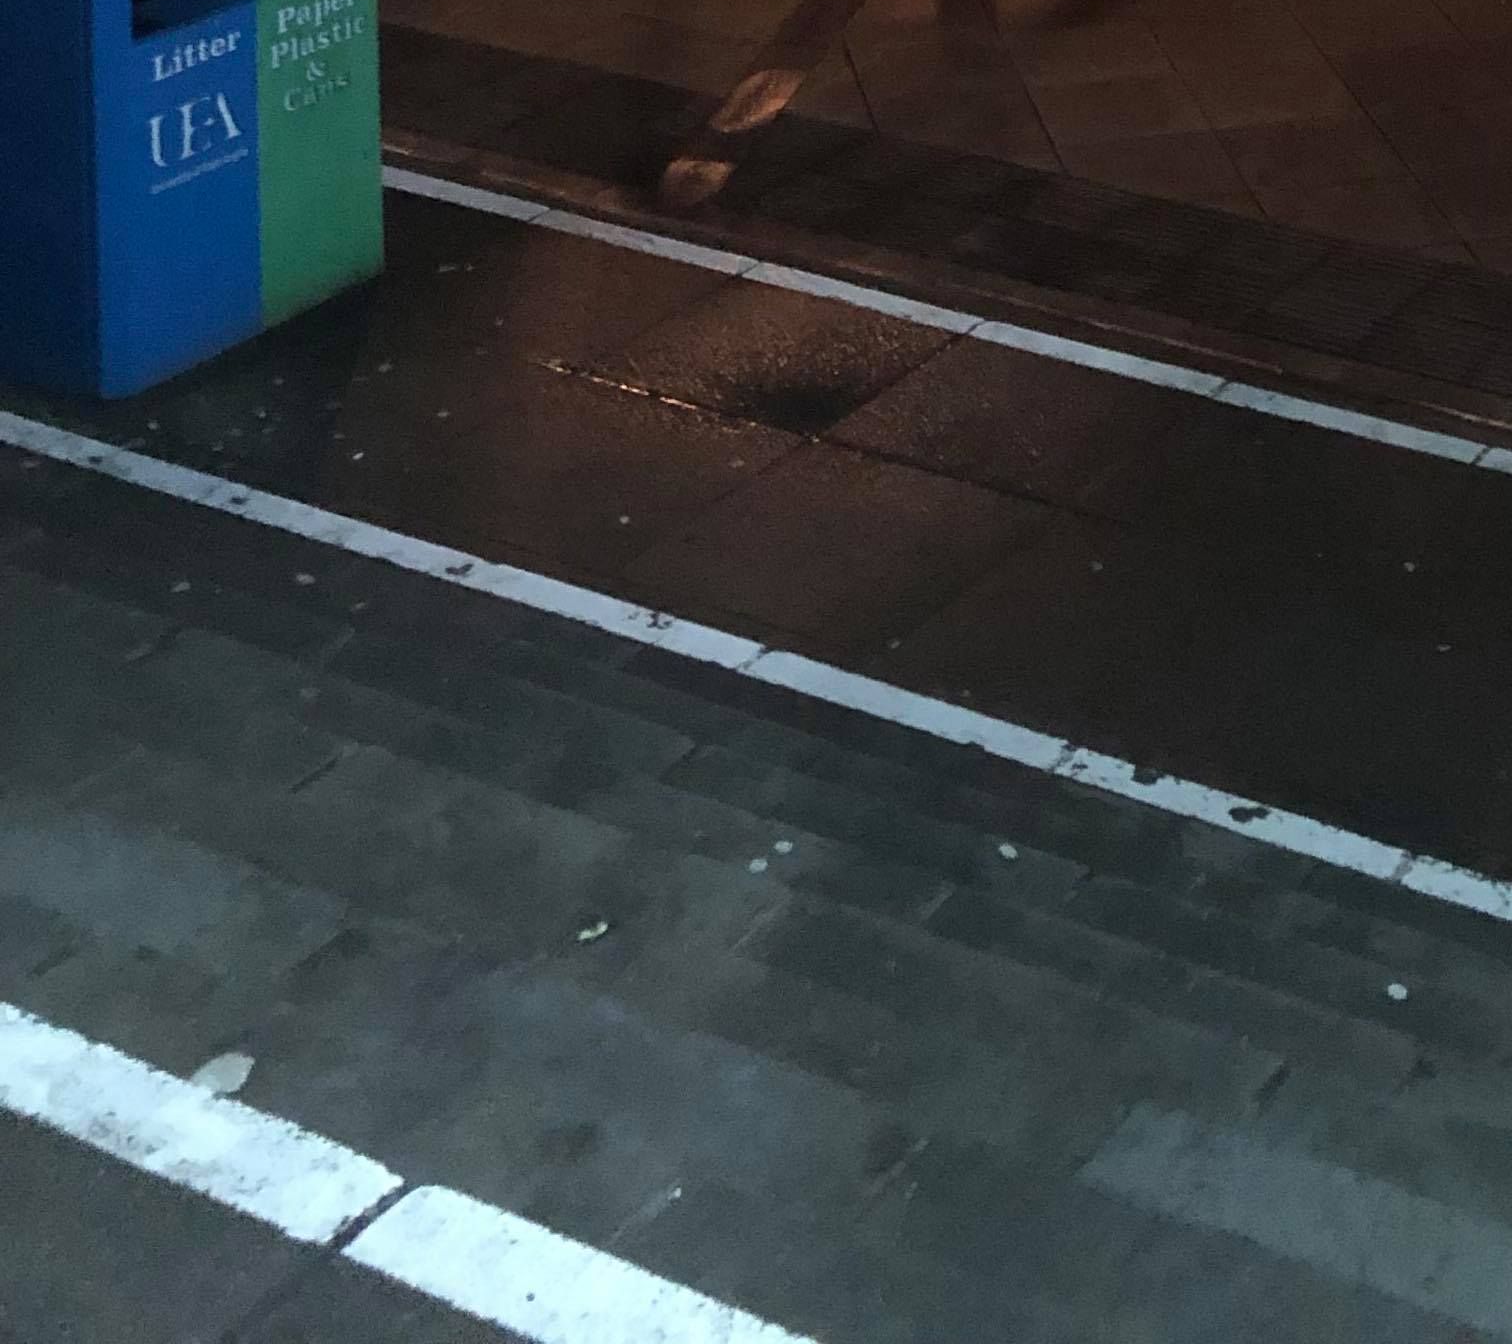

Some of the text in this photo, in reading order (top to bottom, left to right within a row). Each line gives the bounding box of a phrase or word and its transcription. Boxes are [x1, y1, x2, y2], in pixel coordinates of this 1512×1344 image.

[152, 30, 241, 82] Litter
[271, 16, 366, 70] Plastic
[306, 61, 326, 82] &
[149, 93, 242, 168] UEA
